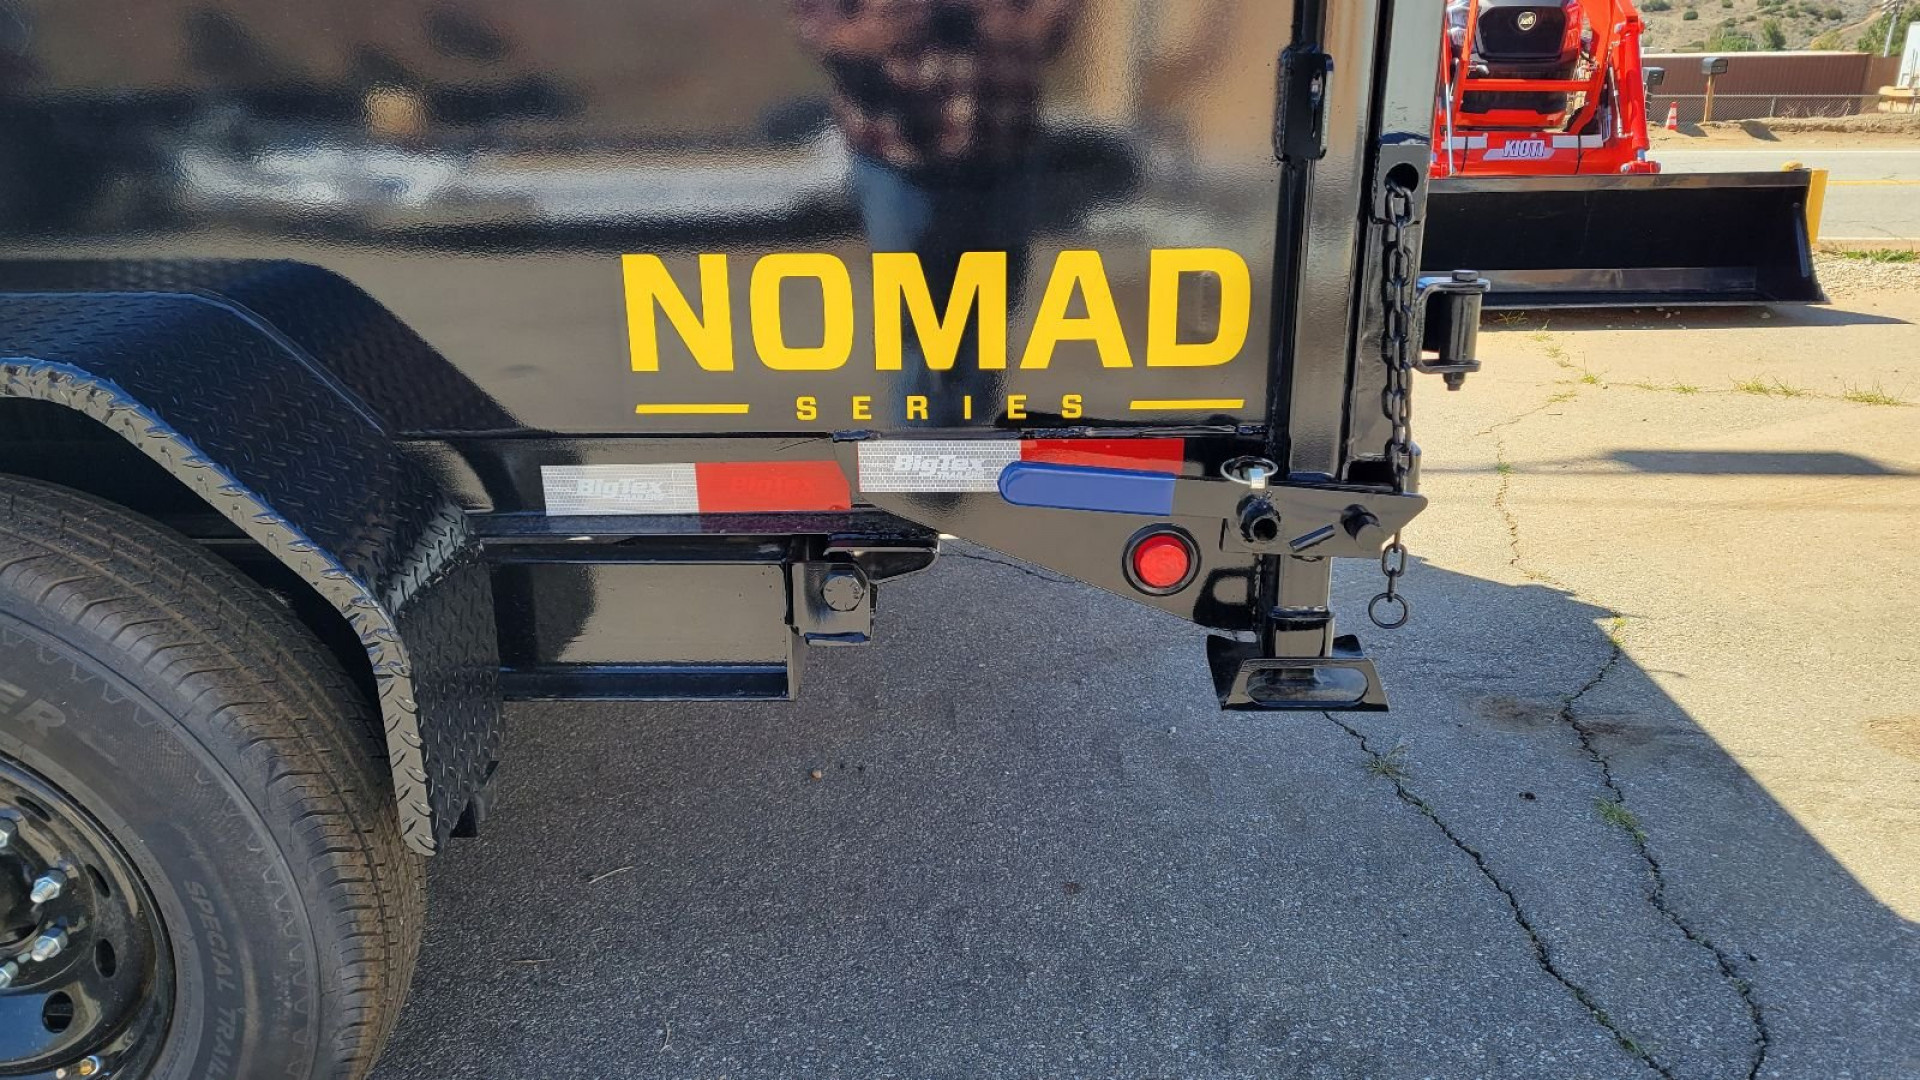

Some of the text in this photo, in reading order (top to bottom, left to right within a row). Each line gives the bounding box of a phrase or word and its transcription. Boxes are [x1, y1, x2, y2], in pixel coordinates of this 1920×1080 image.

[1503, 139, 1545, 157] KIOTI
[622, 246, 1250, 372] NOMAD
[797, 395, 1082, 420] SERIES
[184, 880, 236, 991] SPECIAL
[204, 1006, 236, 1080] TRAIL
